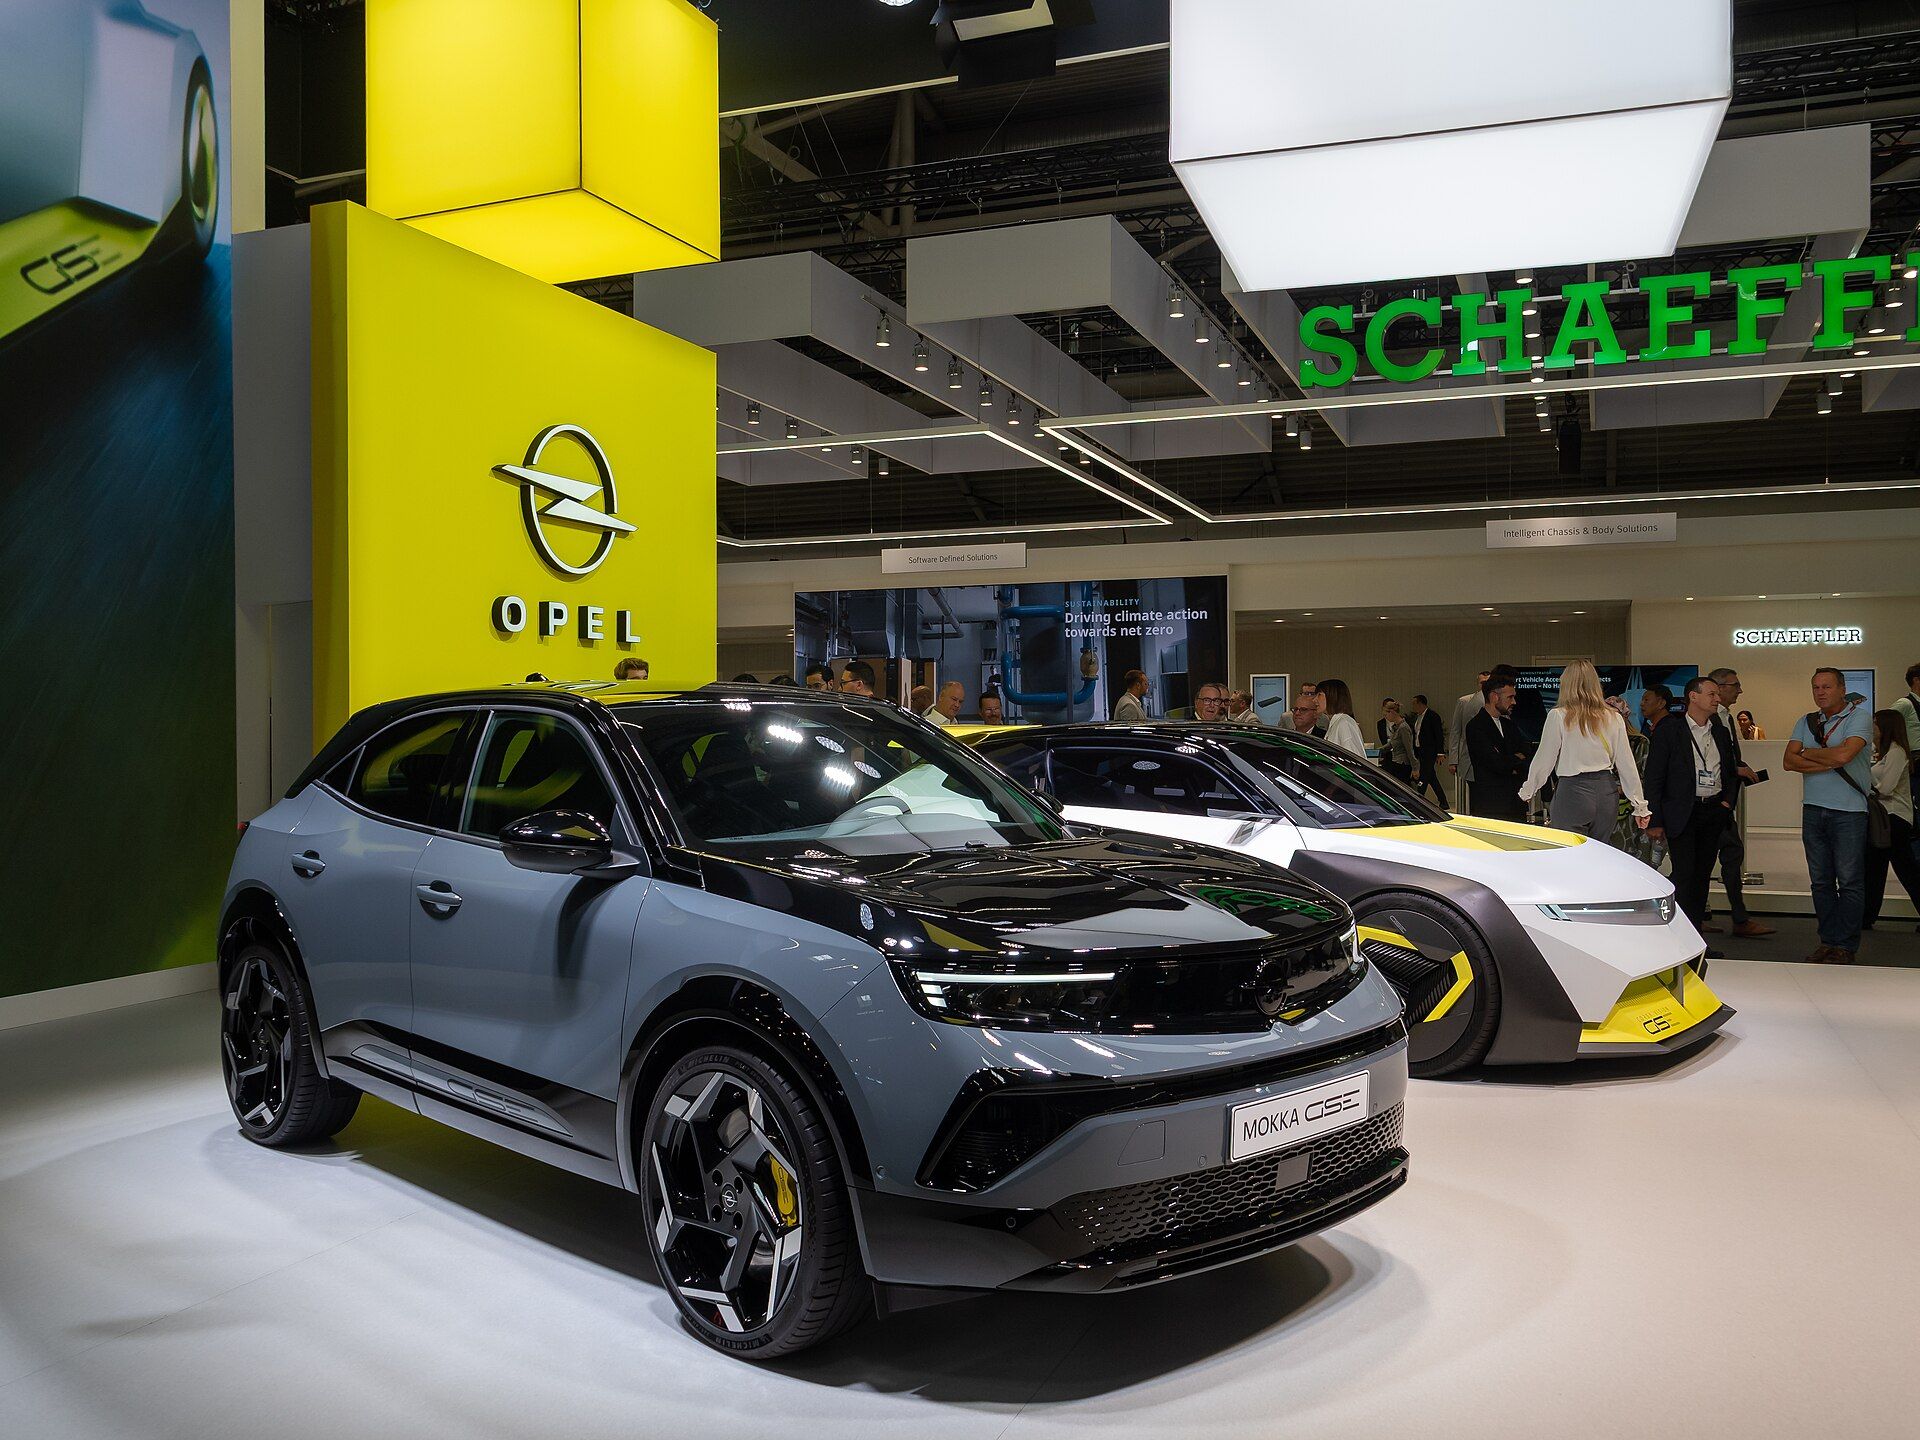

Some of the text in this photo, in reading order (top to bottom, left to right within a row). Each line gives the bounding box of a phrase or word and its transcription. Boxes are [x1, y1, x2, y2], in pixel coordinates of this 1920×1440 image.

[1300, 252, 1920, 389] SCHAEFF
[1503, 524, 1658, 539] Intelligent Chassis & Body Solutions
[908, 553, 998, 564] Software Defined Solutions
[1065, 598, 1140, 608] SUSTAINABILITY
[492, 595, 641, 643] OPEL
[1065, 608, 1208, 624] Driving climate action
[1065, 626, 1174, 638] towards net zero
[1735, 629, 1861, 645] SCHAEFFLER
[446, 1079, 538, 1122] GSE
[1243, 1089, 1360, 1141] MOKKA GSE
[715, 1337, 760, 1350] MICHELIN
